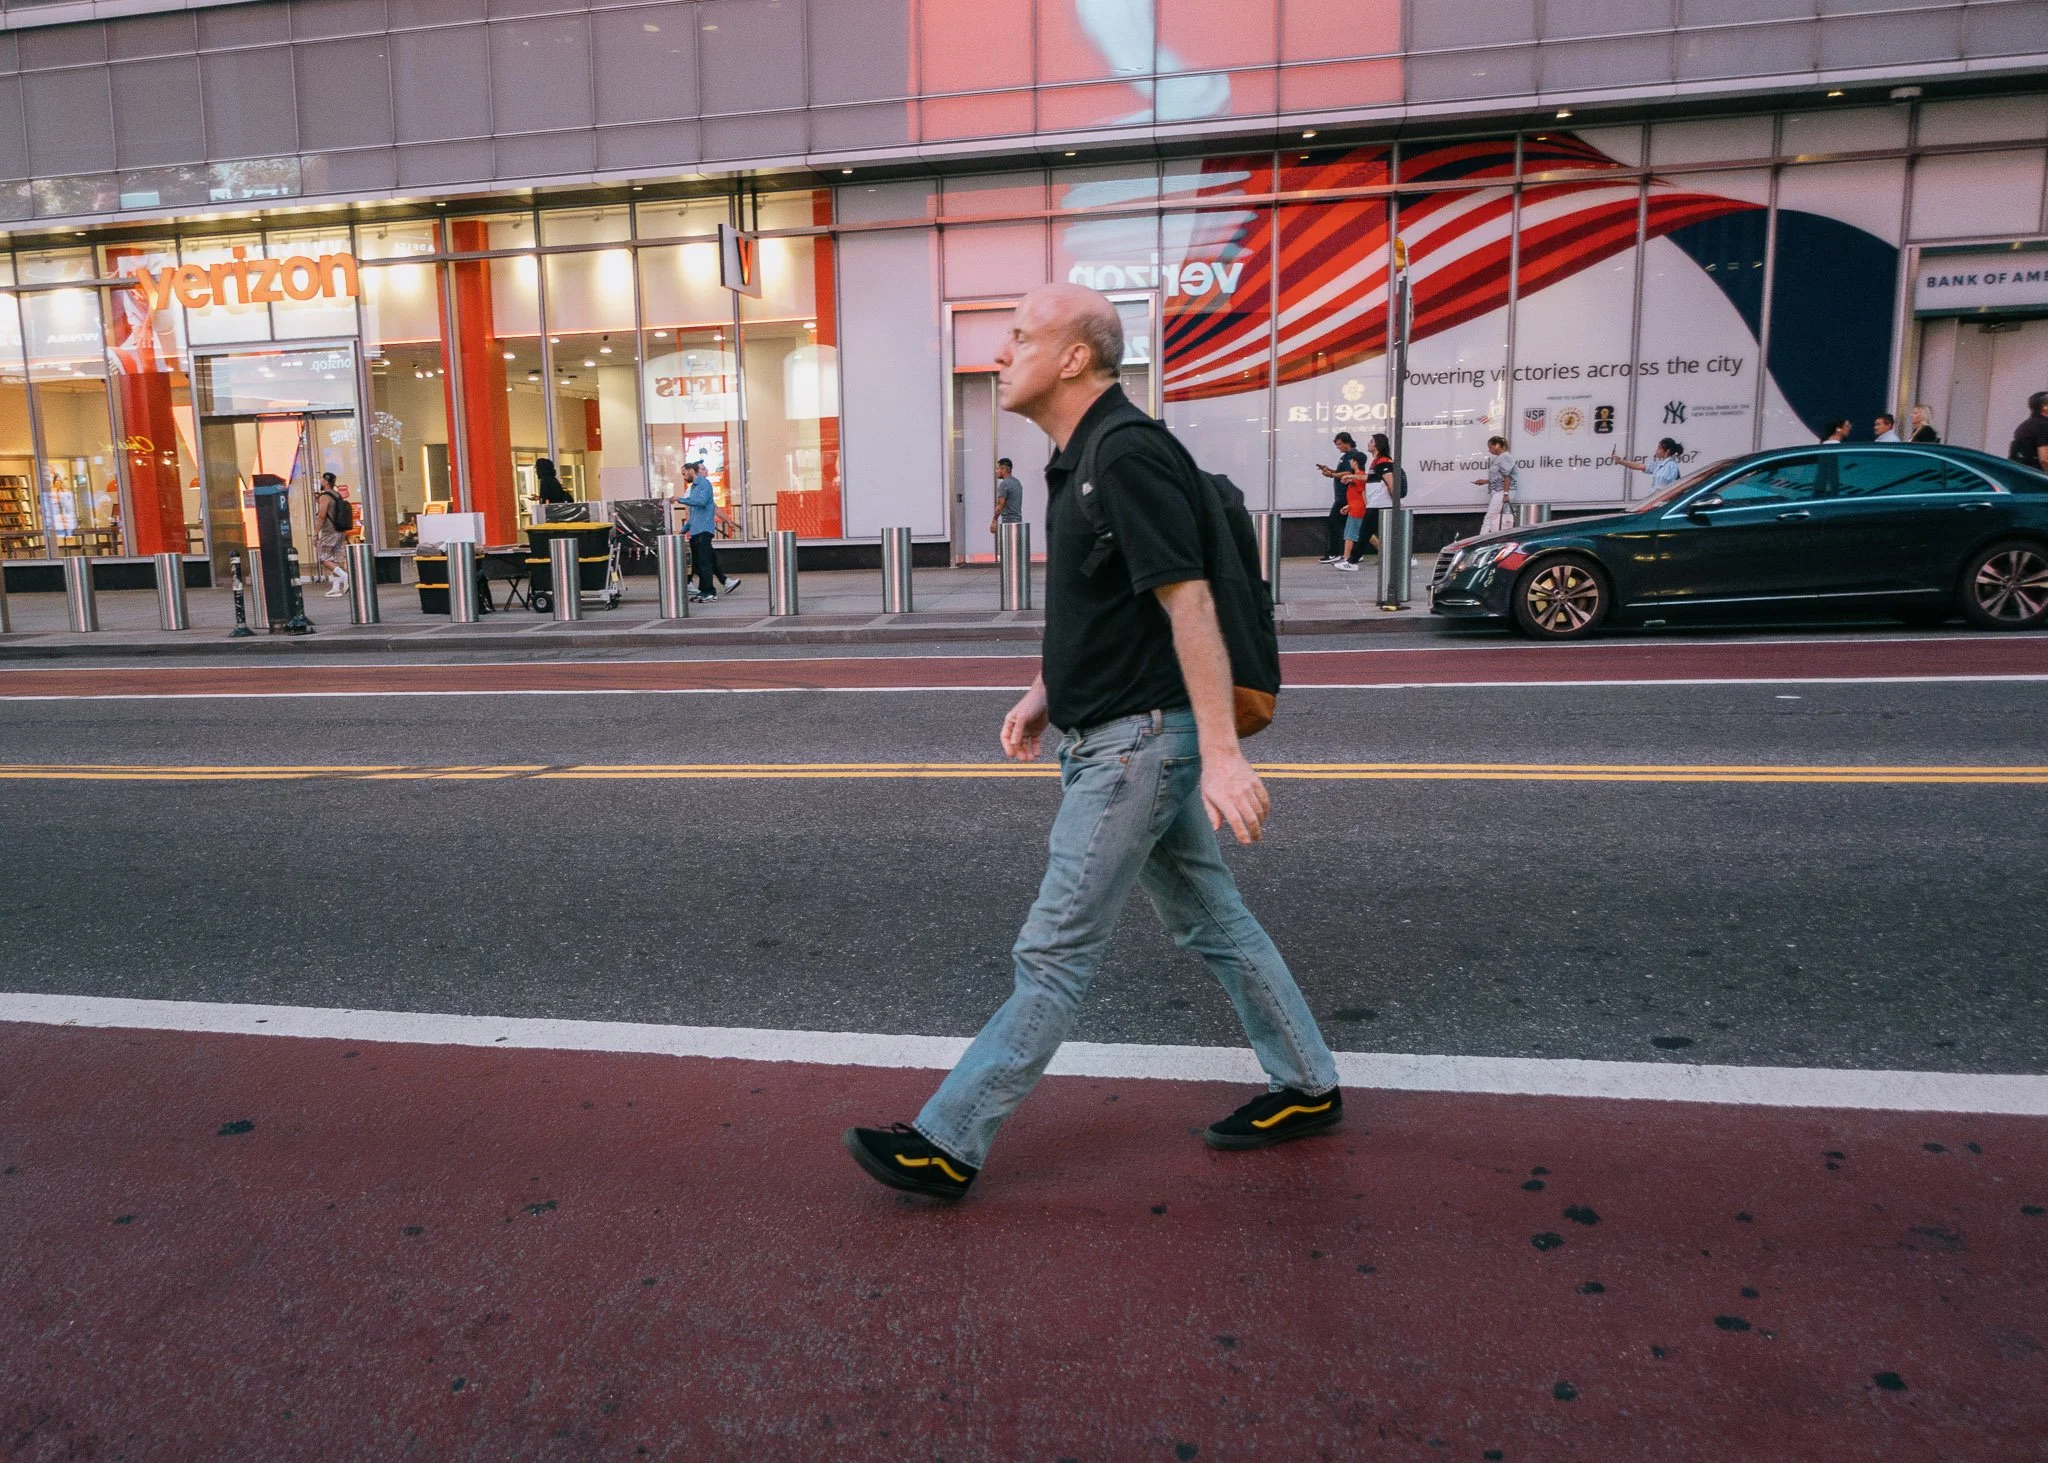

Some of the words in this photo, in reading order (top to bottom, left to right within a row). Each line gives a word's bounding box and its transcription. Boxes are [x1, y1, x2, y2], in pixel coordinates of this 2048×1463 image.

[135, 246, 359, 311] verizon
[1926, 275, 1978, 288] BANK
[1984, 273, 2007, 285] OF
[1491, 363, 1579, 382] victories
[1587, 362, 1659, 378] across
[1667, 356, 1699, 374] the
[1707, 355, 1743, 376] city
[1525, 409, 1545, 421] USA
[1419, 459, 1454, 472] What
[1460, 457, 1494, 470] woul
[1540, 456, 1567, 468] like
[1568, 455, 1591, 467] the
[1596, 455, 1648, 469] poer
